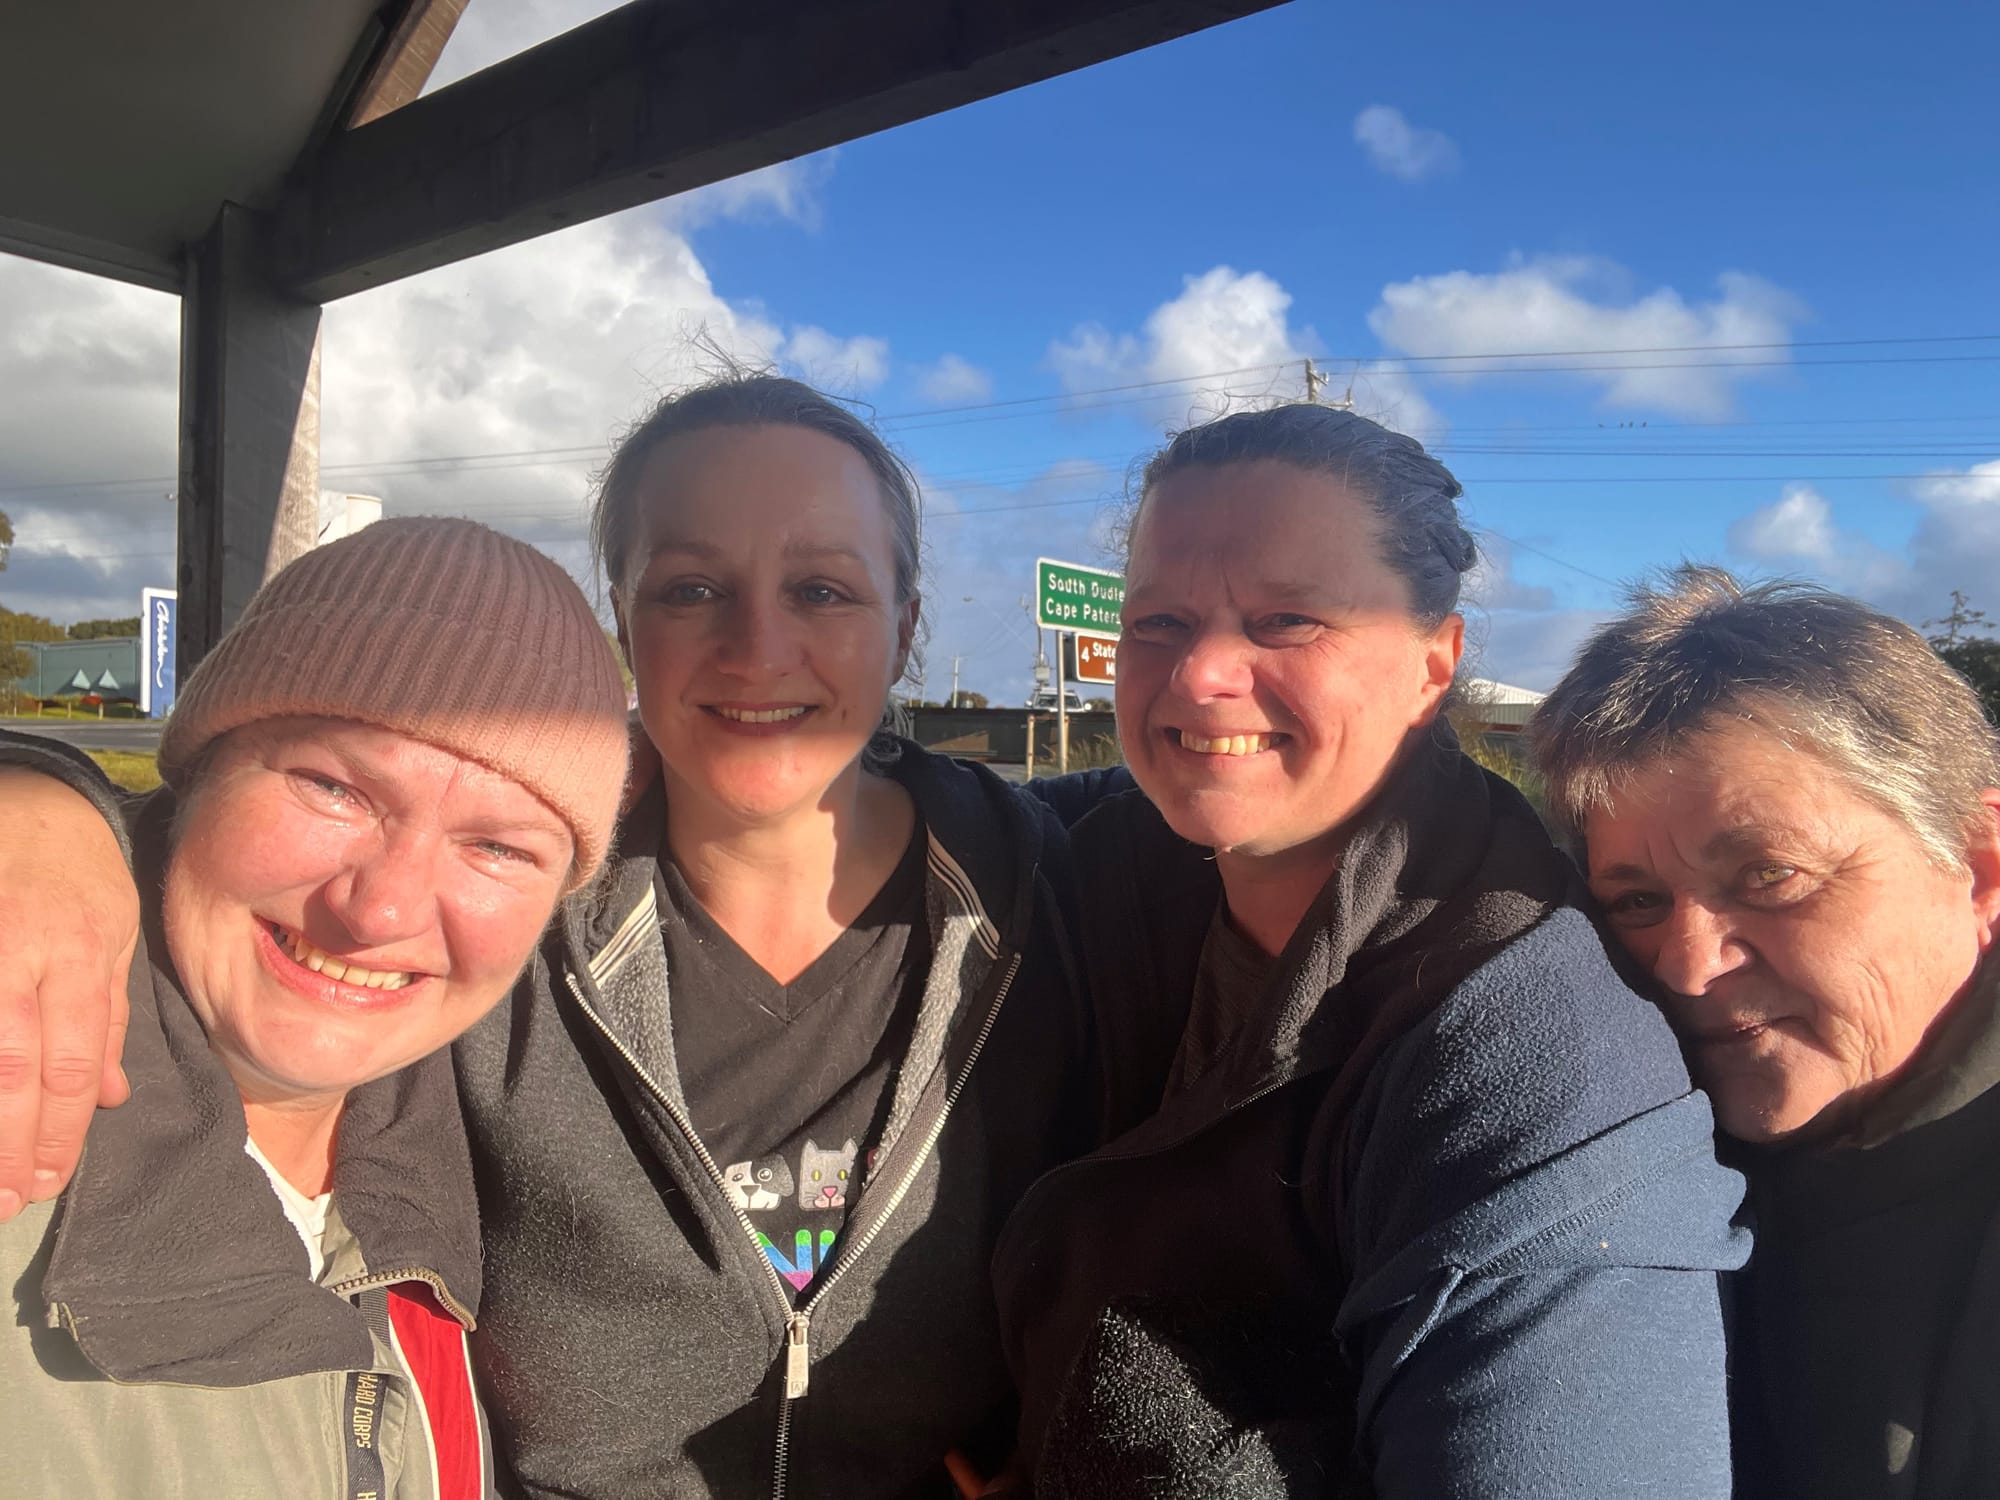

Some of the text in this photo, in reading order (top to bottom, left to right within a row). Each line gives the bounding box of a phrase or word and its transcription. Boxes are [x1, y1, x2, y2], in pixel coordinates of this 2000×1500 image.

[1048, 572, 1086, 596] South
[1046, 597, 1078, 621] Cape
[1081, 646, 1090, 662] 4
[353, 1373, 378, 1448] HARD CORPS
